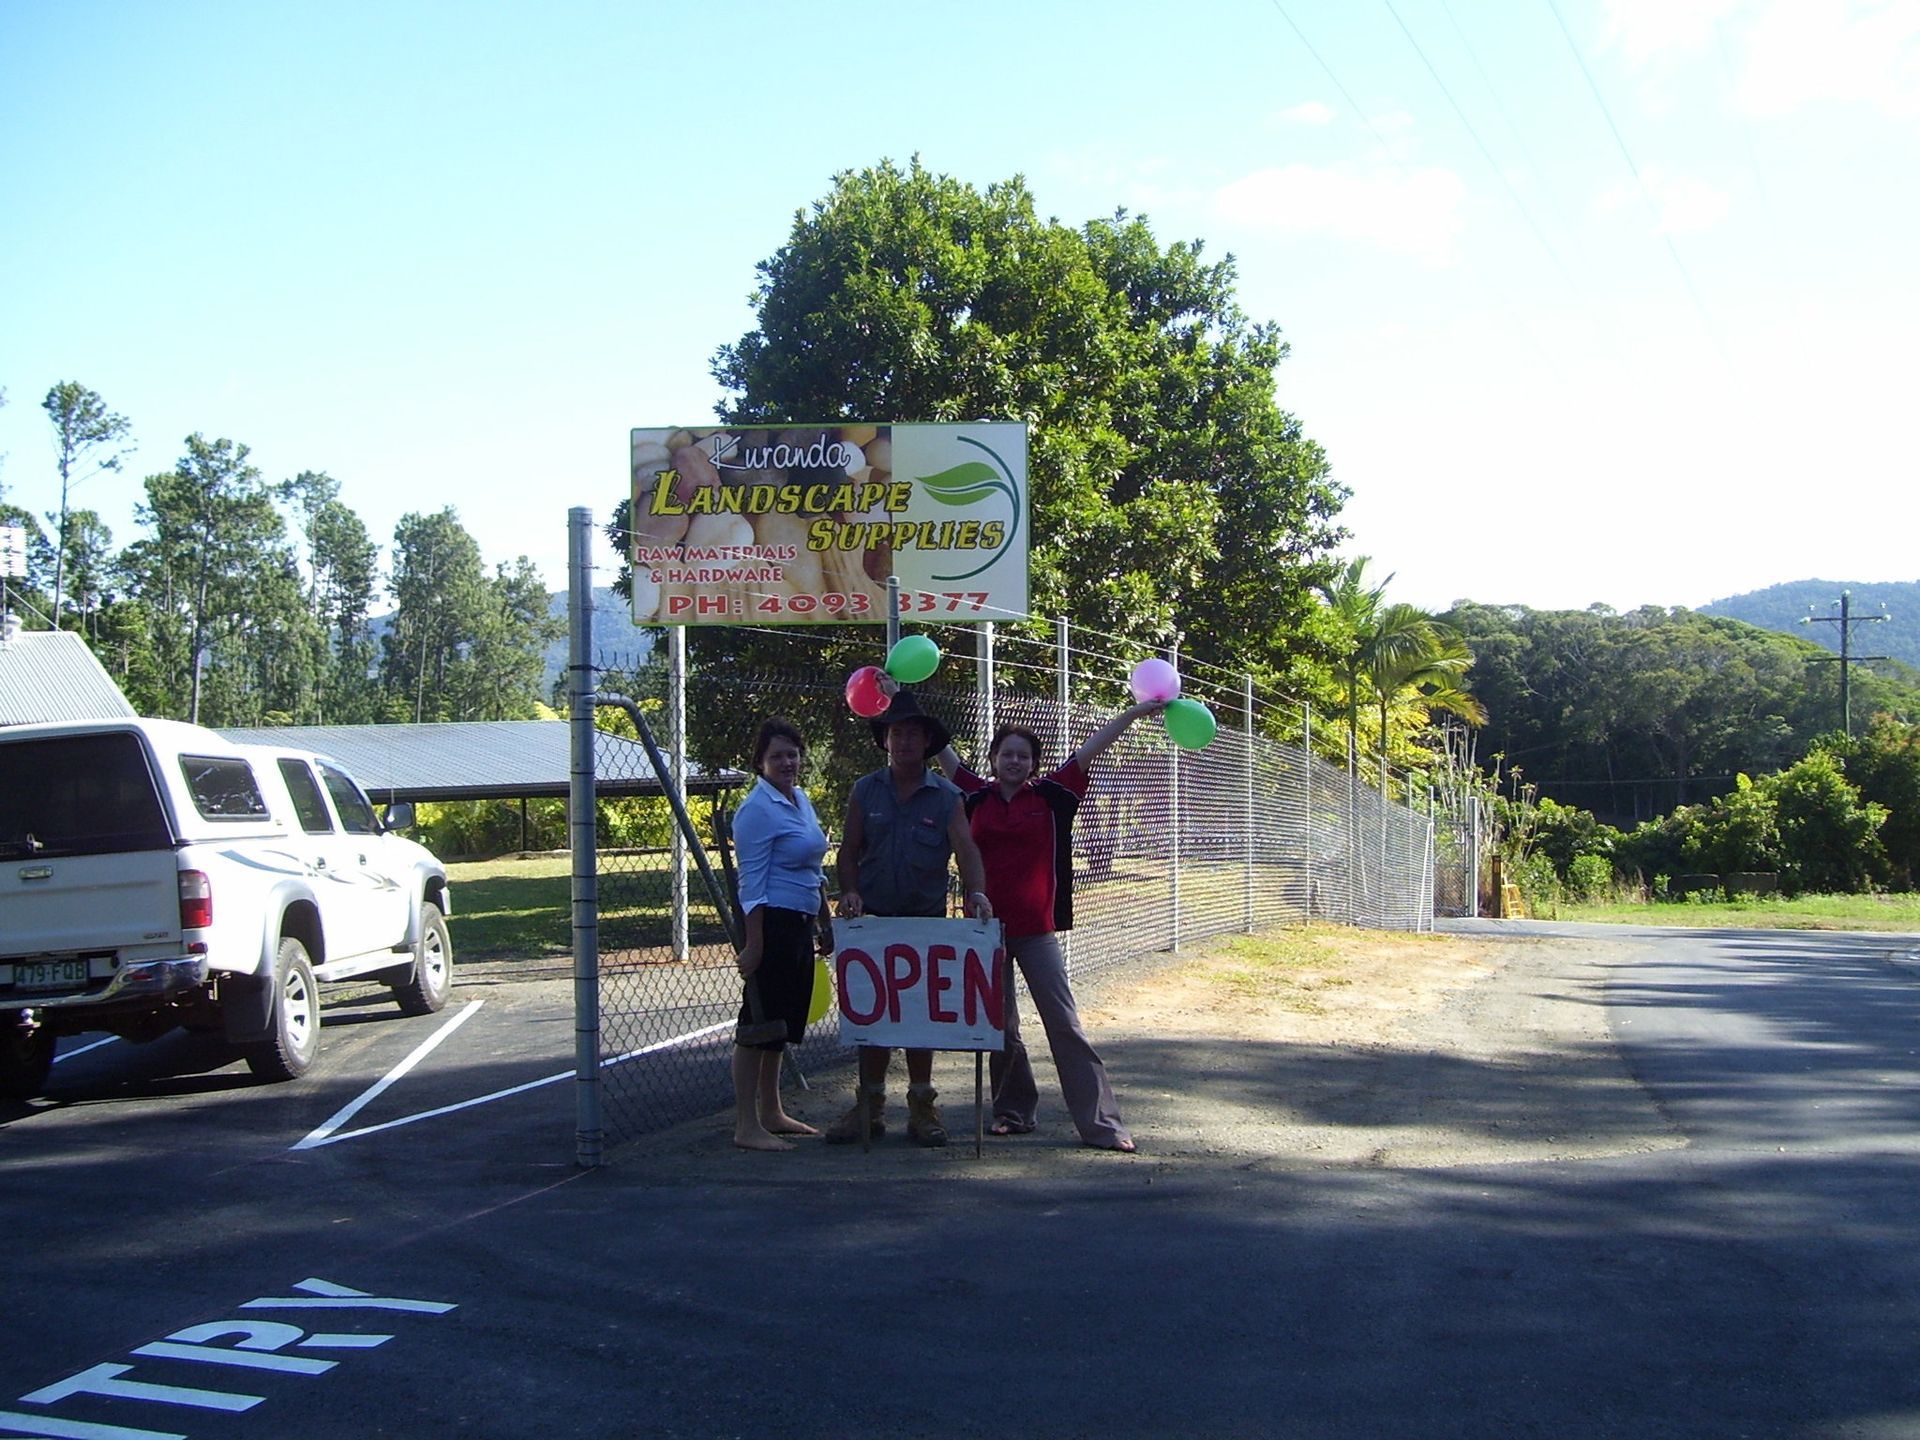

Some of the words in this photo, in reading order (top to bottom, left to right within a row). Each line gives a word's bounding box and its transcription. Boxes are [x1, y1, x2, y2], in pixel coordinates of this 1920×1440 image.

[709, 434, 851, 471] Kuranda
[649, 470, 912, 516] LANDSCAPE
[807, 518, 1005, 551] SUPPLIES
[637, 546, 684, 562] RAW
[686, 545, 797, 562] MATERIALS
[650, 568, 663, 583] &
[668, 567, 784, 584] HARDWARE
[668, 594, 744, 615] PH:
[757, 592, 871, 614] 4093
[898, 592, 990, 613] 3377
[836, 943, 1005, 1031] OPEN
